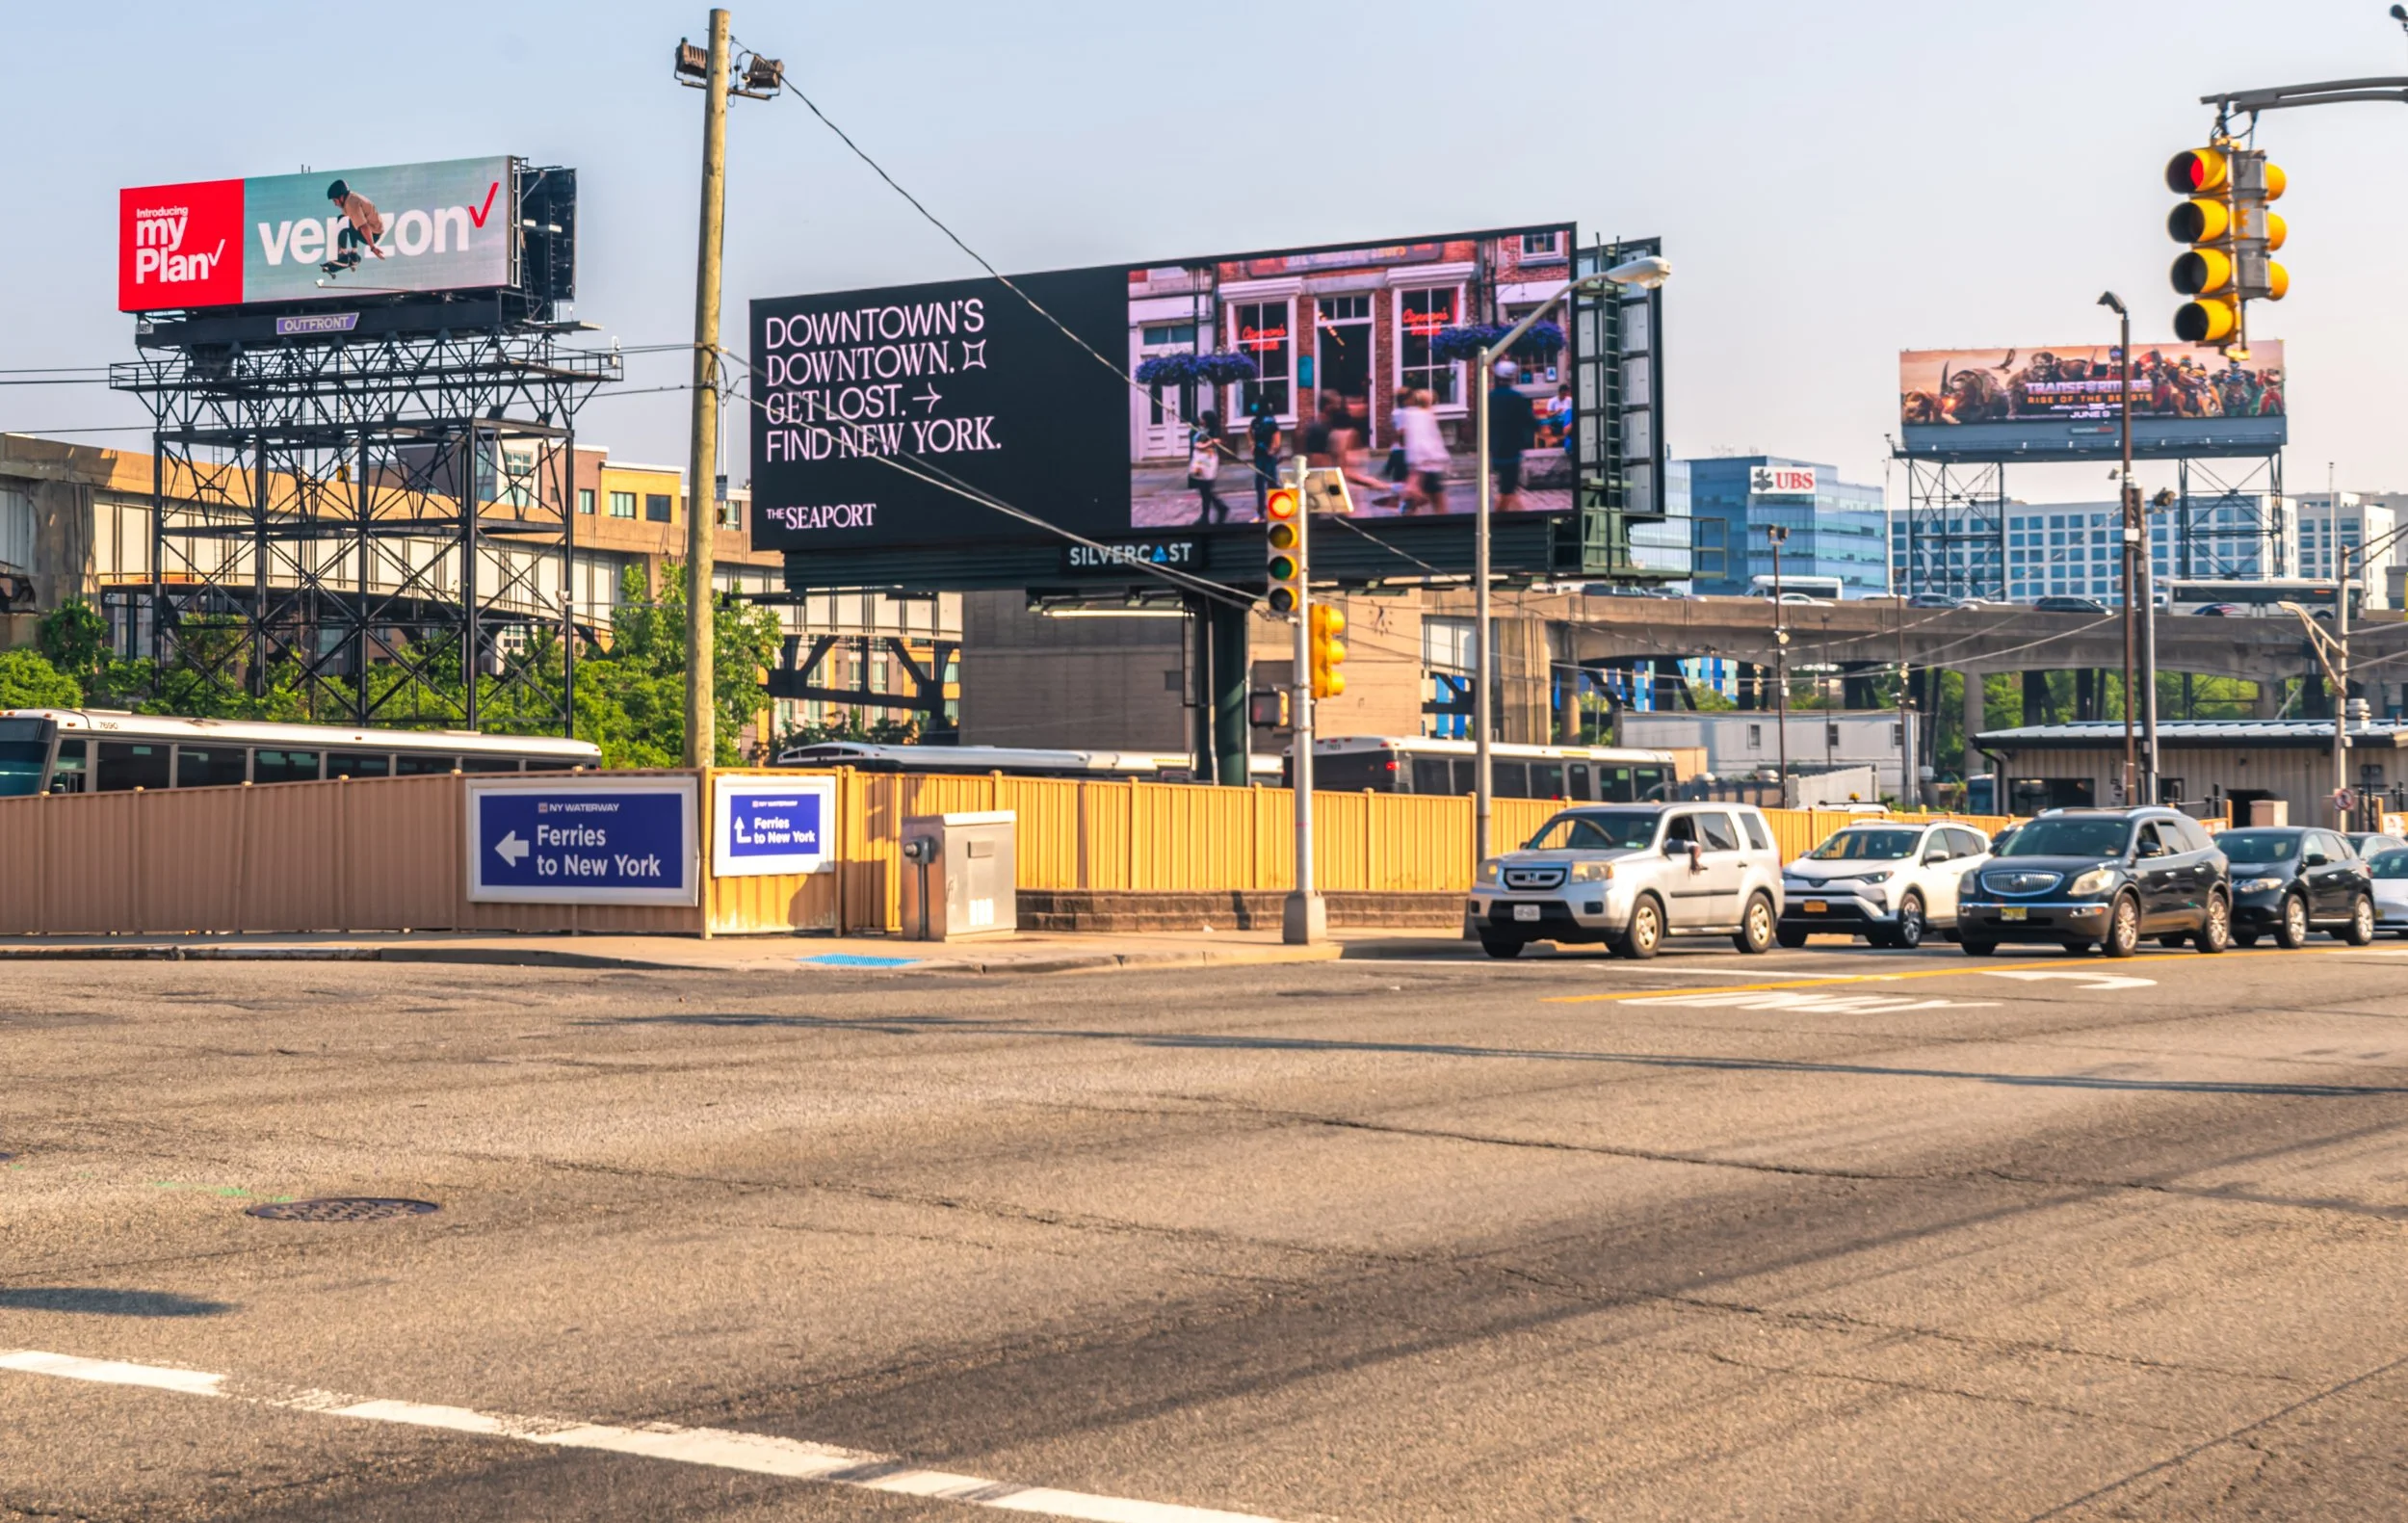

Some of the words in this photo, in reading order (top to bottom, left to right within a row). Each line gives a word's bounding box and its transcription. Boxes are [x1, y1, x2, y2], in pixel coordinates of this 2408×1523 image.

[137, 206, 188, 218] Introducing
[136, 217, 188, 251] my
[257, 205, 469, 266] verzon
[136, 247, 209, 284] Plan
[284, 316, 350, 331] OUTFRONT
[766, 298, 985, 350] DOWNTOWN'S
[766, 340, 955, 387] DOWNTOWN.
[766, 389, 820, 425] GET
[825, 383, 906, 421] LOST.
[2059, 395, 2074, 404] OF
[2080, 394, 2103, 403] THE
[2107, 393, 2153, 403] BESTS
[767, 428, 833, 462] FIND
[839, 422, 905, 460] NEW
[910, 416, 1003, 455] YORK.
[1775, 472, 1814, 489] UBS
[766, 508, 785, 520] THE
[785, 503, 877, 530] SEAPORT
[99, 722, 118, 730] 7690
[549, 803, 563, 812] NY
[564, 803, 619, 812] WATERWAY
[754, 816, 790, 829] Ferries
[537, 824, 607, 847] Ferries
[754, 831, 766, 844] to
[768, 830, 791, 844] New
[792, 829, 816, 843] York
[537, 854, 558, 876] to
[564, 853, 608, 876] New
[614, 853, 662, 877] York
